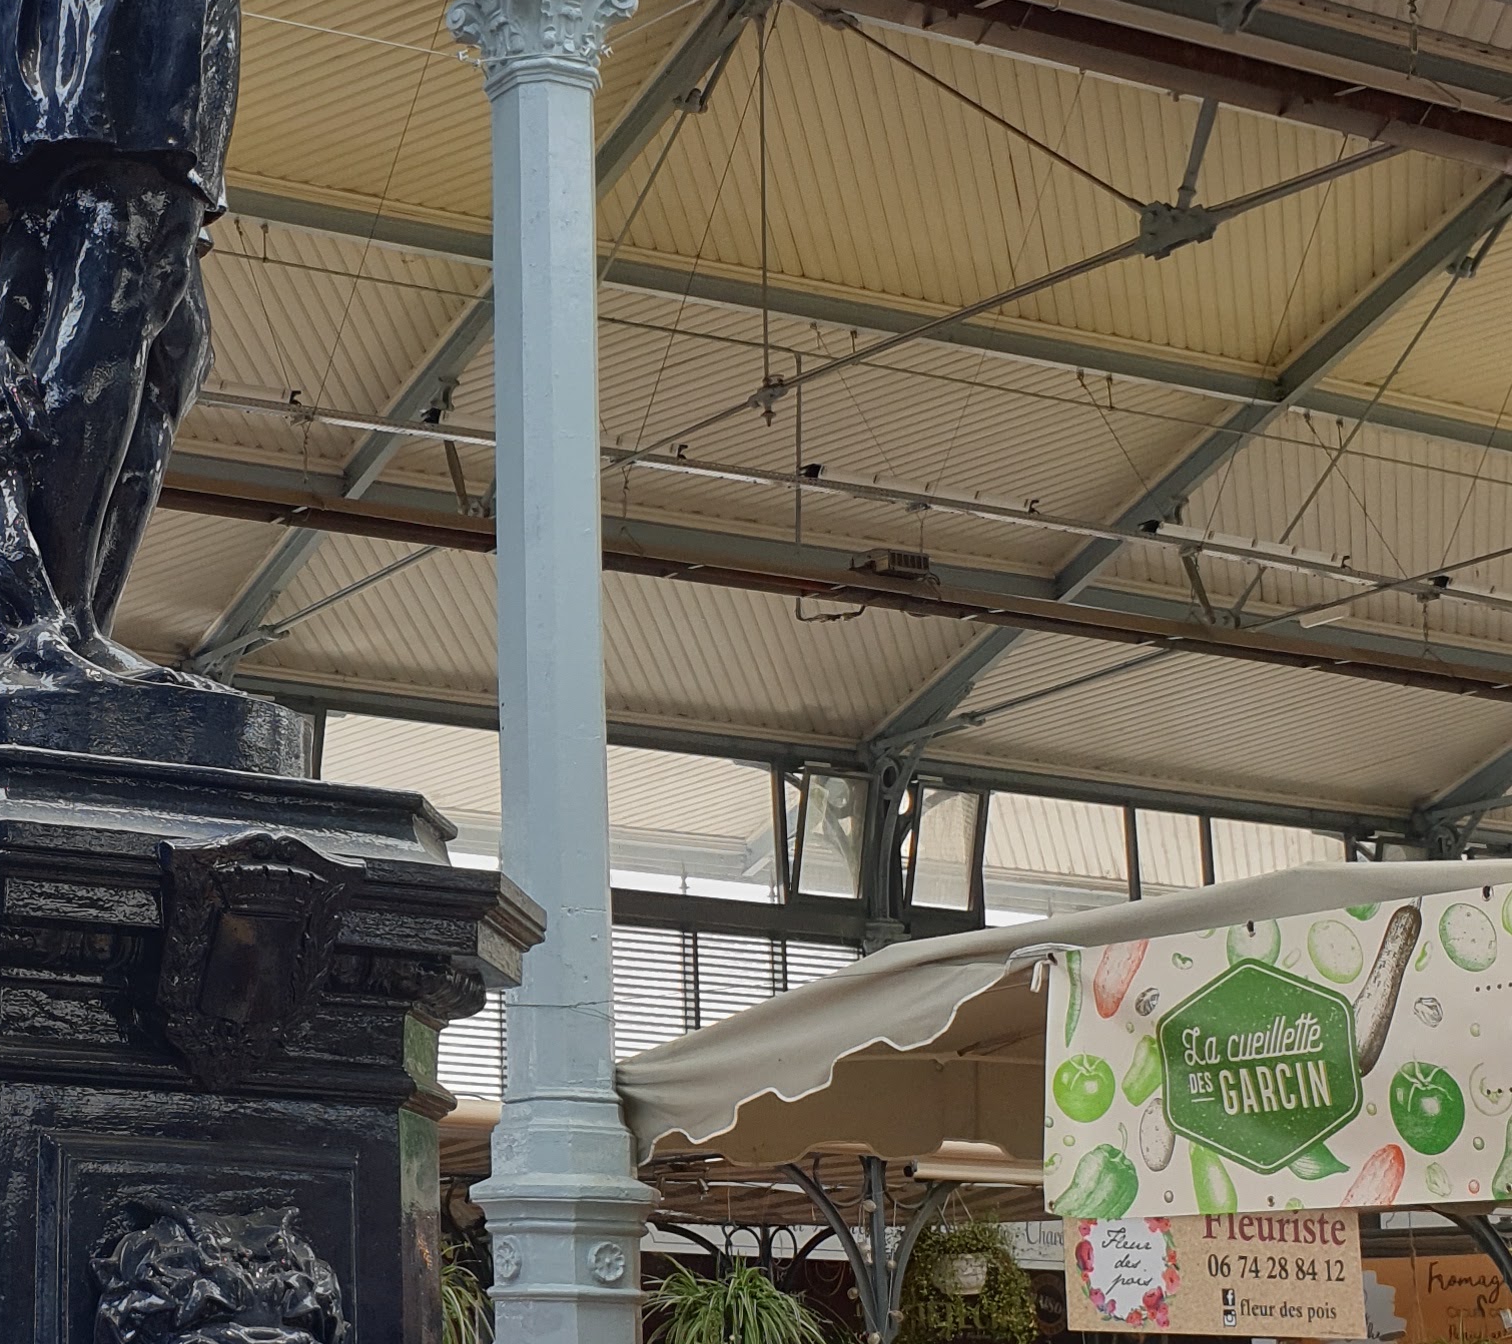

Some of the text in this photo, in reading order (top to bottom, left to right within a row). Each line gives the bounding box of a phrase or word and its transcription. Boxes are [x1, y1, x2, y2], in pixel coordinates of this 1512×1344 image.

[1182, 1012, 1323, 1066] La cueillette
[1189, 1060, 1332, 1115] DES GARCIN
[1101, 1227, 1152, 1250] Fleur
[1202, 1211, 1347, 1246] Fleuriste
[1114, 1253, 1141, 1269] des
[1207, 1254, 1346, 1282] 06 74 28 84 12
[1105, 1269, 1153, 1295] pois
[1240, 1298, 1337, 1323] fleur des pois
